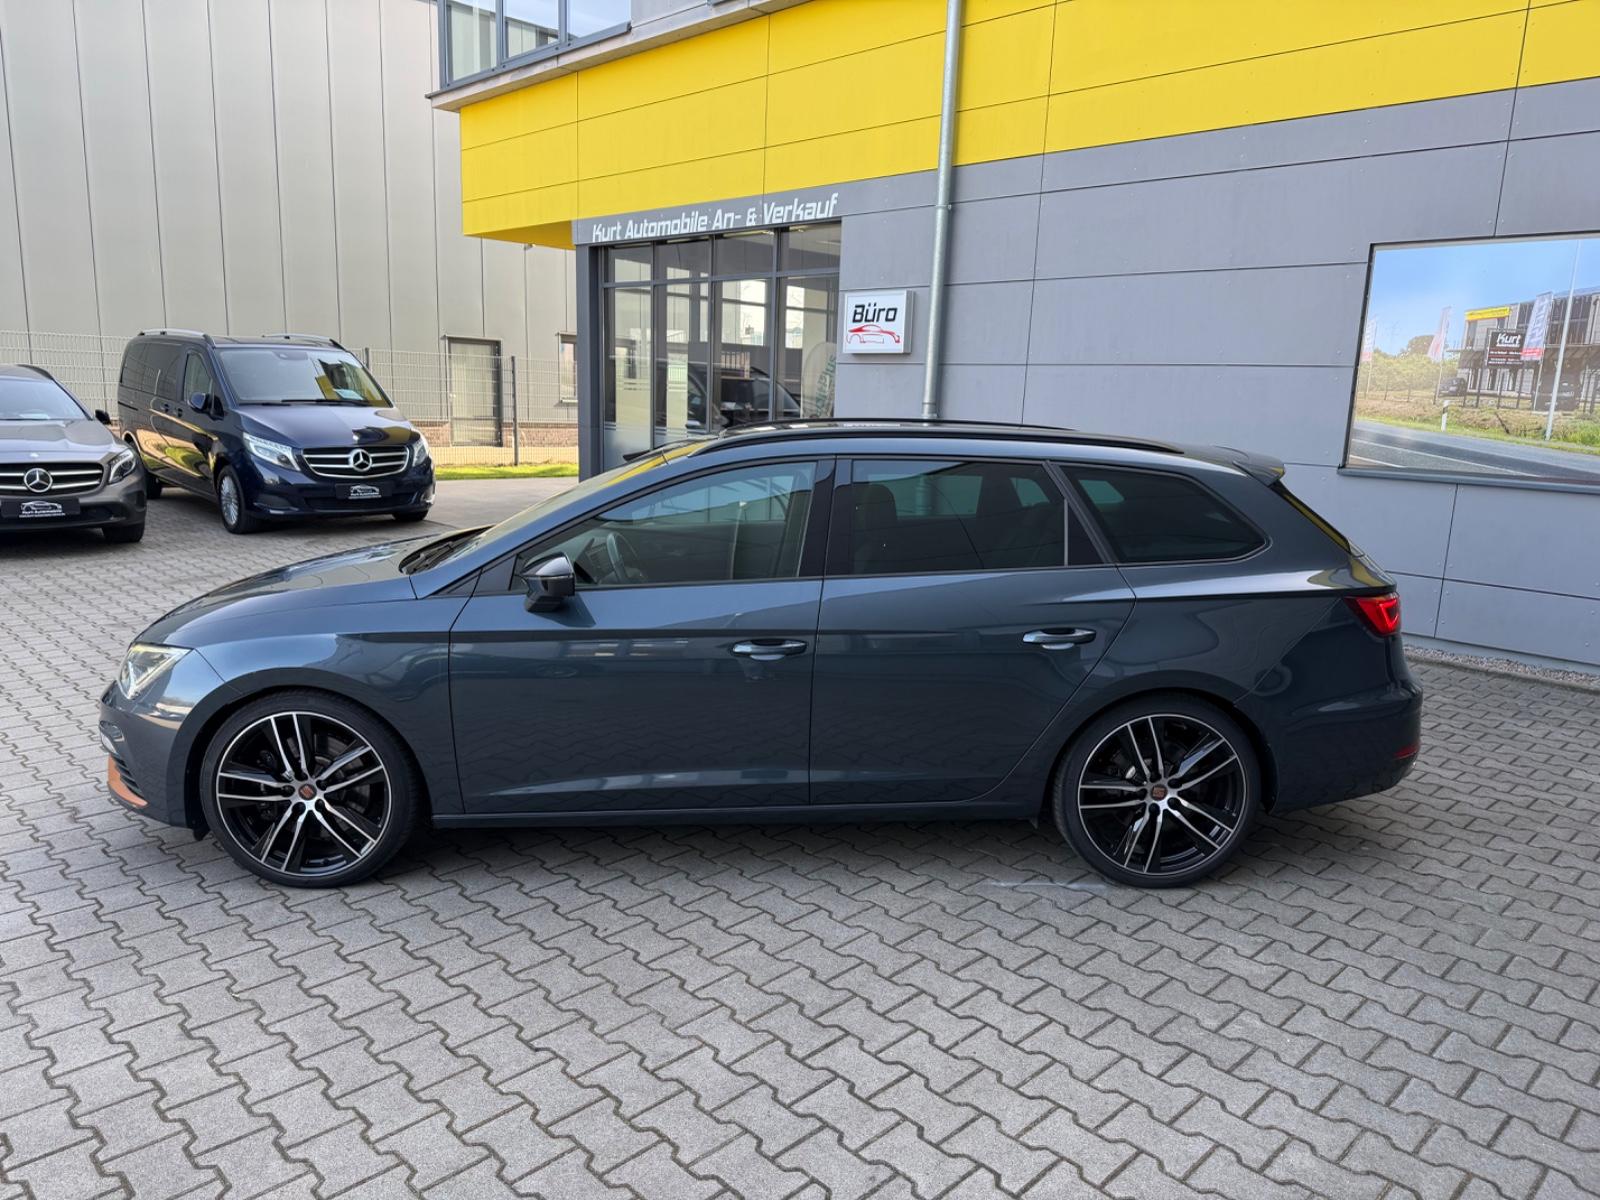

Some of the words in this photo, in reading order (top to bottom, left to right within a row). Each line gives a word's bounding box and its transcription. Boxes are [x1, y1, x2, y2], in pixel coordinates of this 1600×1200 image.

[592, 221, 622, 243] Kurt
[624, 211, 708, 240] Automobile
[712, 208, 742, 230] An-
[746, 207, 758, 226] &
[763, 192, 839, 225] Verkauf
[852, 302, 898, 323] Büro
[1496, 332, 1521, 345] Kurt
